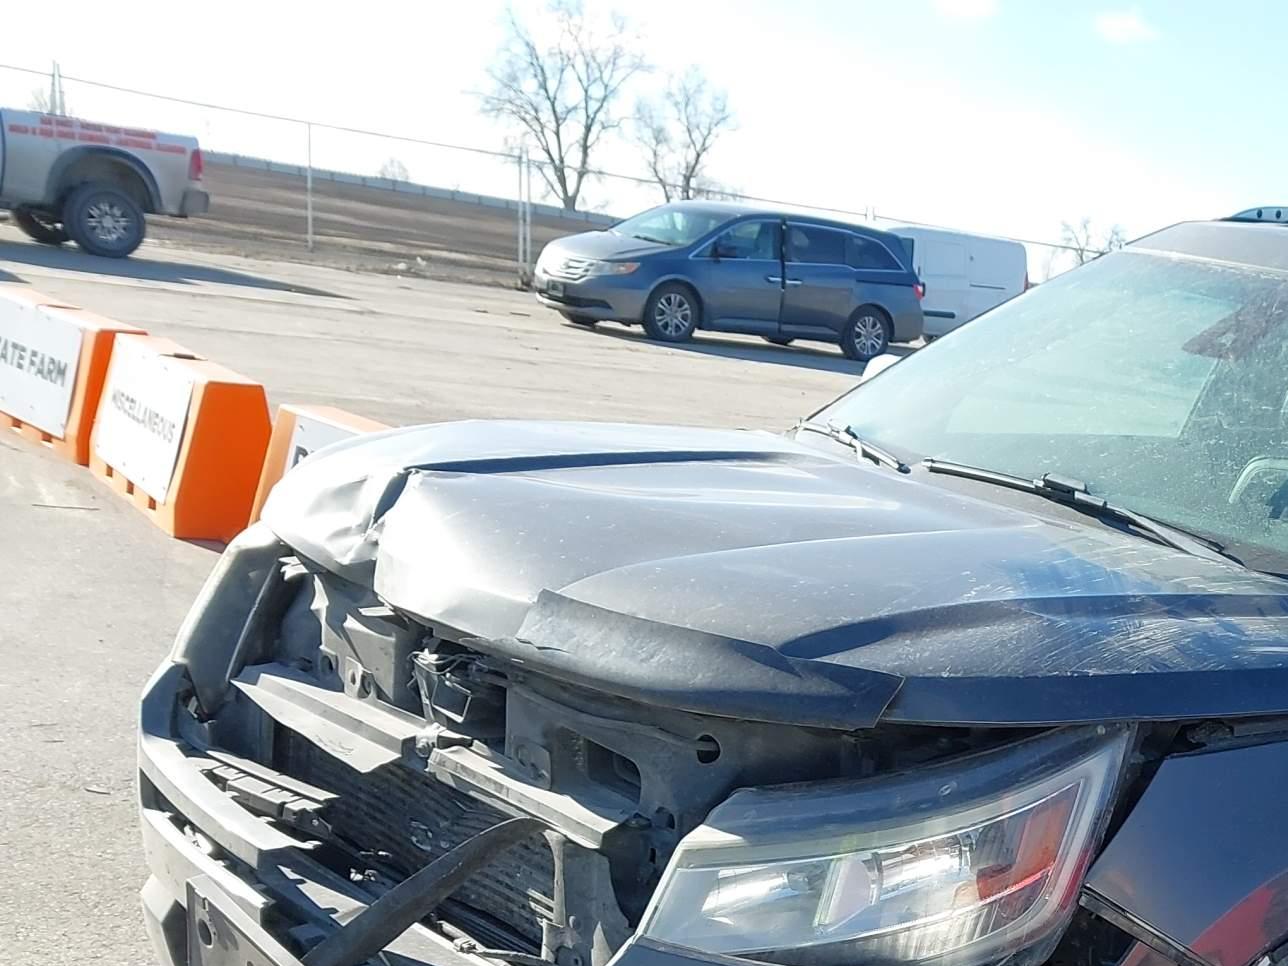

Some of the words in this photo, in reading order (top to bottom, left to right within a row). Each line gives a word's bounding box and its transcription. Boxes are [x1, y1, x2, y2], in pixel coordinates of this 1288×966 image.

[0, 337, 26, 370] ATE
[27, 349, 68, 388] FARM
[112, 389, 176, 444] MISCELLANEOUS
